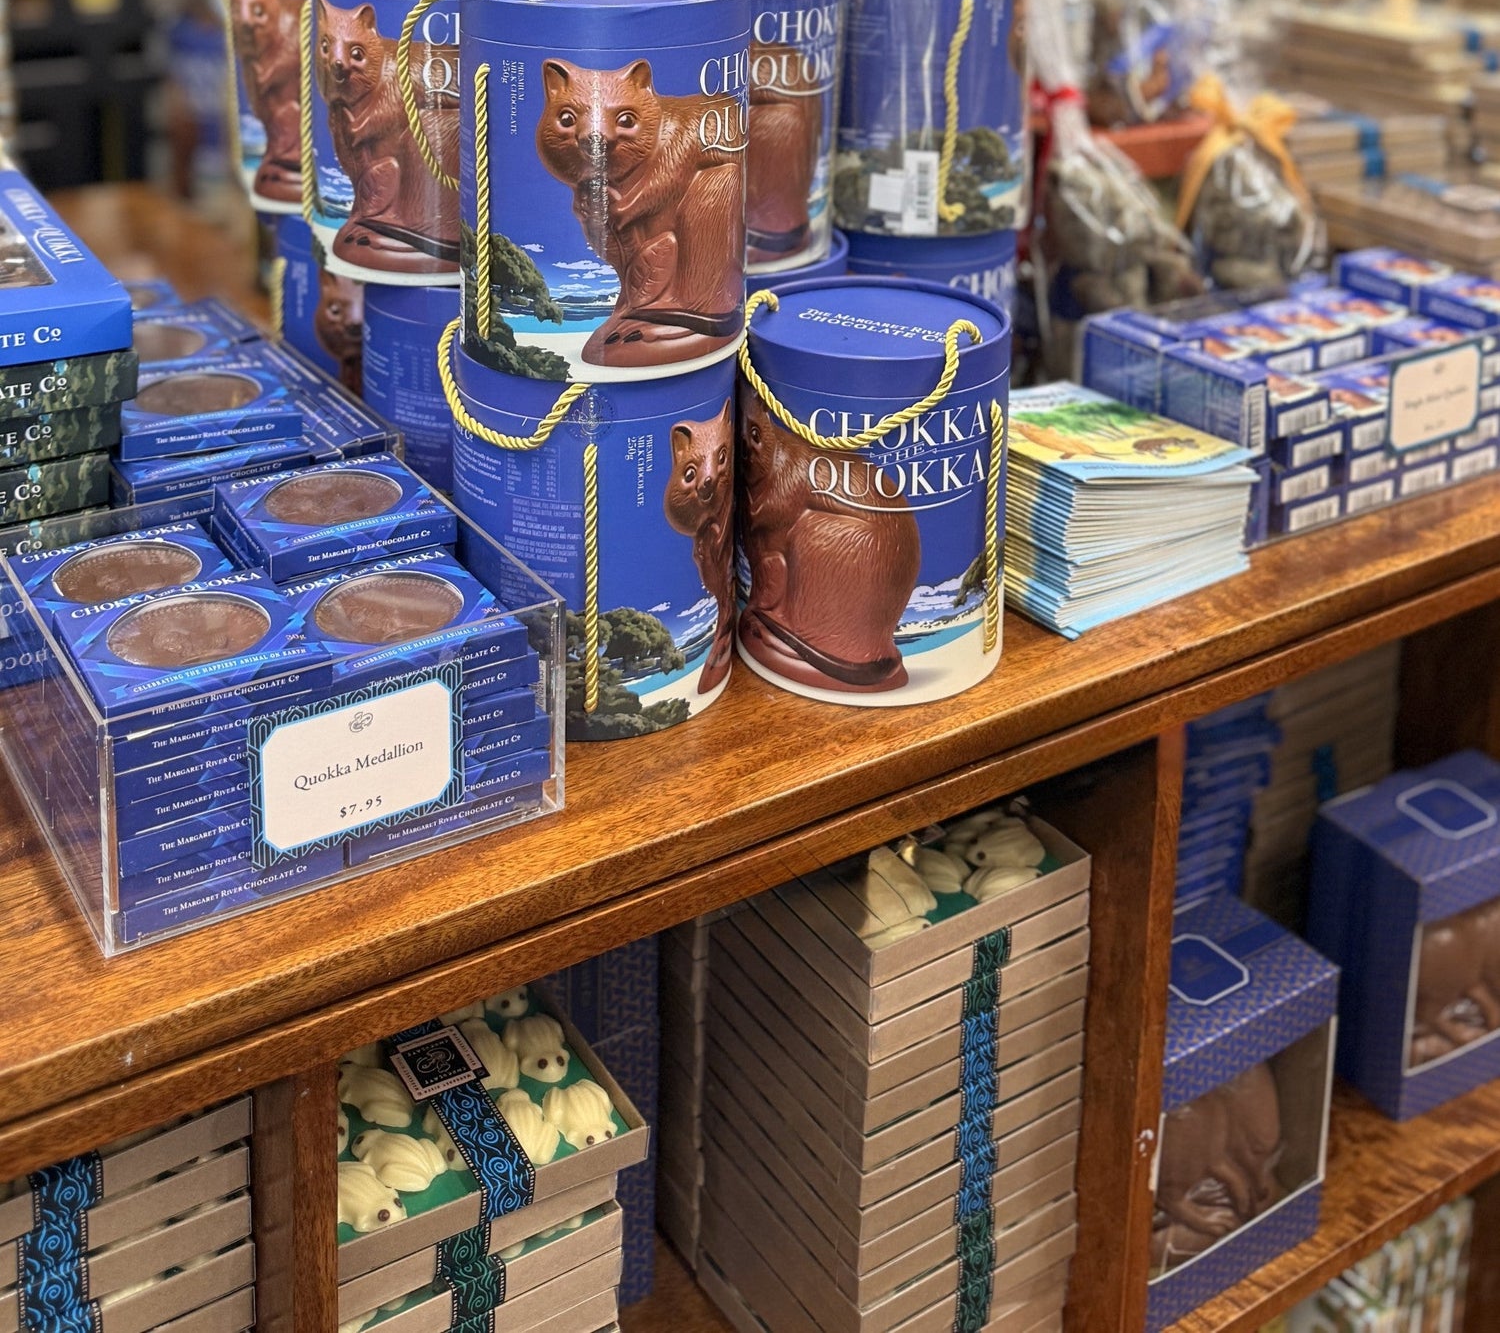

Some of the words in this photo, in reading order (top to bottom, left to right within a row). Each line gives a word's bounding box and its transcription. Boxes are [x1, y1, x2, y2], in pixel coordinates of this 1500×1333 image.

[798, 311, 916, 339] CHOCOLATE
[807, 308, 832, 317] THE
[835, 313, 909, 331] MARGARET
[910, 326, 947, 338] RIVE
[170, 433, 202, 443] MARGARET
[203, 430, 221, 439] RIVER
[221, 425, 262, 436] CHOCOLATE
[637, 436, 646, 457] MILK
[625, 437, 636, 461] 250g
[878, 443, 925, 465] THE
[179, 479, 211, 490] MARGARET
[230, 466, 271, 478] CHOCOLATE
[231, 469, 302, 490] CHOKKA
[323, 454, 392, 470] QUOKKA
[637, 458, 646, 508] CHOCOLATE
[808, 449, 986, 512] QUOKKA
[415, 509, 437, 517] EARTH
[21, 541, 99, 564] CHOKKA
[122, 523, 196, 541] QUOKKA
[307, 554, 321, 563] THE
[322, 547, 356, 559] MARGARET
[357, 543, 376, 552] RIVER
[376, 533, 420, 547] CHOCOLATE
[374, 550, 446, 573] QUOKKA
[71, 594, 156, 619] CHOKKA
[181, 572, 262, 594] QUOKKA
[353, 648, 398, 668] CELEBRATING
[399, 644, 412, 652] THE
[413, 634, 445, 649] HAPPIEST
[446, 629, 471, 640] ANIMAL
[133, 673, 184, 693] CELEBRATING
[186, 669, 201, 677] THE
[202, 660, 237, 674] HAPPIEST
[240, 654, 268, 665] ANIMAL
[270, 651, 281, 659] ON
[282, 648, 307, 656] EARTH
[168, 698, 209, 714] MARGARET
[210, 691, 233, 702] RIVER
[234, 678, 286, 696] CHOCOLATE
[152, 740, 168, 749] THE
[169, 729, 210, 746] MARGARET
[211, 722, 234, 734] RIVER
[464, 739, 510, 757] CHOCOLATE
[146, 776, 162, 785] THE
[164, 764, 204, 782] MARGARET
[205, 757, 228, 769] RIVER
[294, 764, 352, 791] Quokka
[355, 741, 424, 771] Medallion
[464, 774, 510, 793] CHOCOLATE
[155, 805, 171, 815] THE
[172, 794, 213, 810] MARGARET
[213, 786, 236, 798] RIVER
[340, 795, 383, 819] $7.95
[388, 832, 400, 841] THE
[402, 822, 437, 837] MARGARET
[438, 814, 458, 825] RIVER
[458, 799, 503, 818] CHOCOLATE
[159, 841, 175, 852] THE
[177, 830, 217, 847] MARGARET
[218, 823, 240, 834] RIVER
[156, 875, 172, 884] THE
[173, 863, 214, 880] MARGARET
[215, 855, 237, 867] RIVER
[163, 906, 178, 916] THE
[180, 894, 220, 912] MARGARET
[221, 886, 243, 898] RIVER
[243, 870, 295, 890] CHOCOLATE
